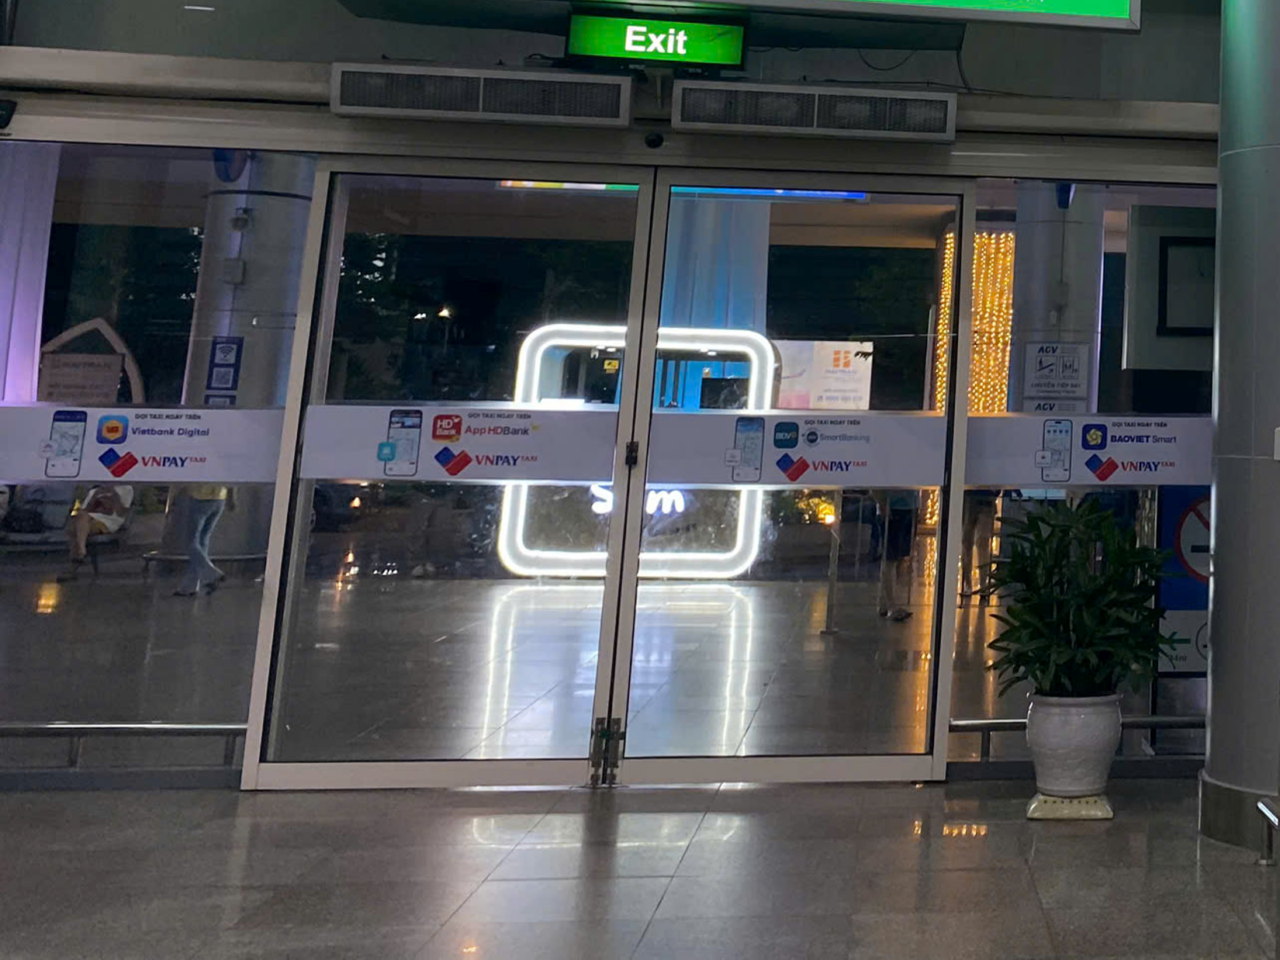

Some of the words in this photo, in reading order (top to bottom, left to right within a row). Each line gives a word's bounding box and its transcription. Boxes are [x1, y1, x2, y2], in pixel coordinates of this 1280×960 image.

[625, 25, 688, 55] Exit
[437, 419, 453, 429] HD
[132, 427, 175, 436] Vietbank
[178, 428, 210, 437] Digital
[465, 426, 487, 436] App
[488, 426, 530, 435] HDBank
[1111, 435, 1151, 443] BAOVIET
[1152, 435, 1177, 443] Smart
[141, 456, 188, 467] VNPAY
[475, 455, 520, 466] VNPAY
[812, 461, 852, 472] VNPAY
[1121, 461, 1160, 472] VNPAY
